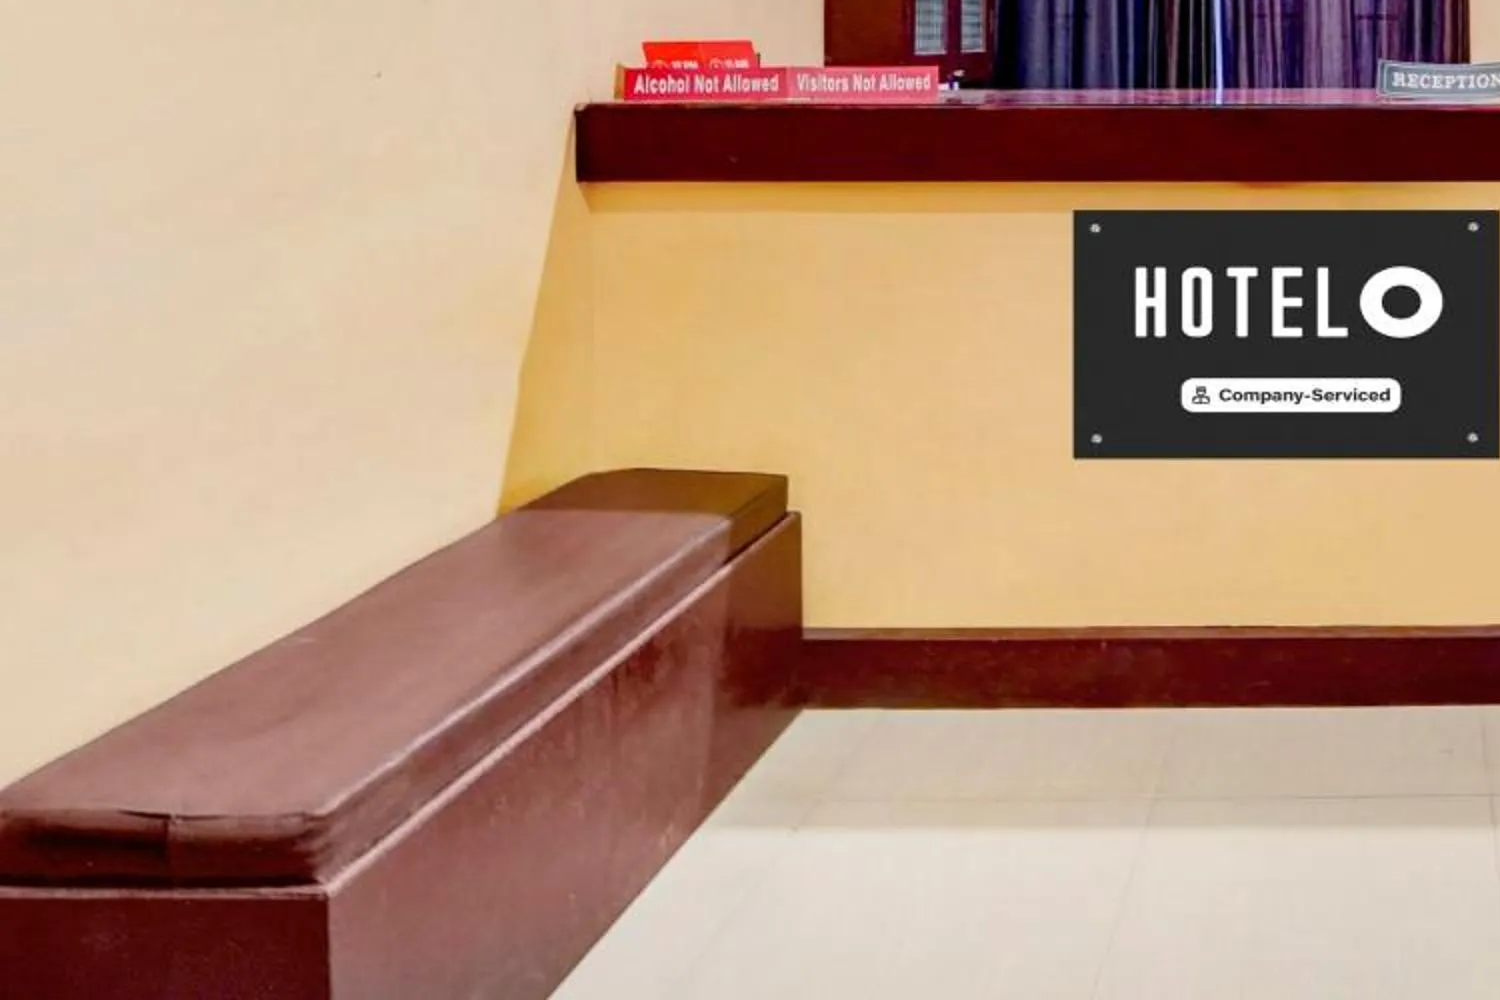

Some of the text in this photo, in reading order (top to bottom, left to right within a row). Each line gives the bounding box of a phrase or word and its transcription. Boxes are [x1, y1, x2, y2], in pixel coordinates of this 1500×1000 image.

[634, 73, 780, 95] Alcohol Not Allowed
[797, 73, 932, 92] Visitors Not Allowed
[1134, 266, 1350, 338] HOTEL
[1218, 387, 1392, 405] Company-Serviced
